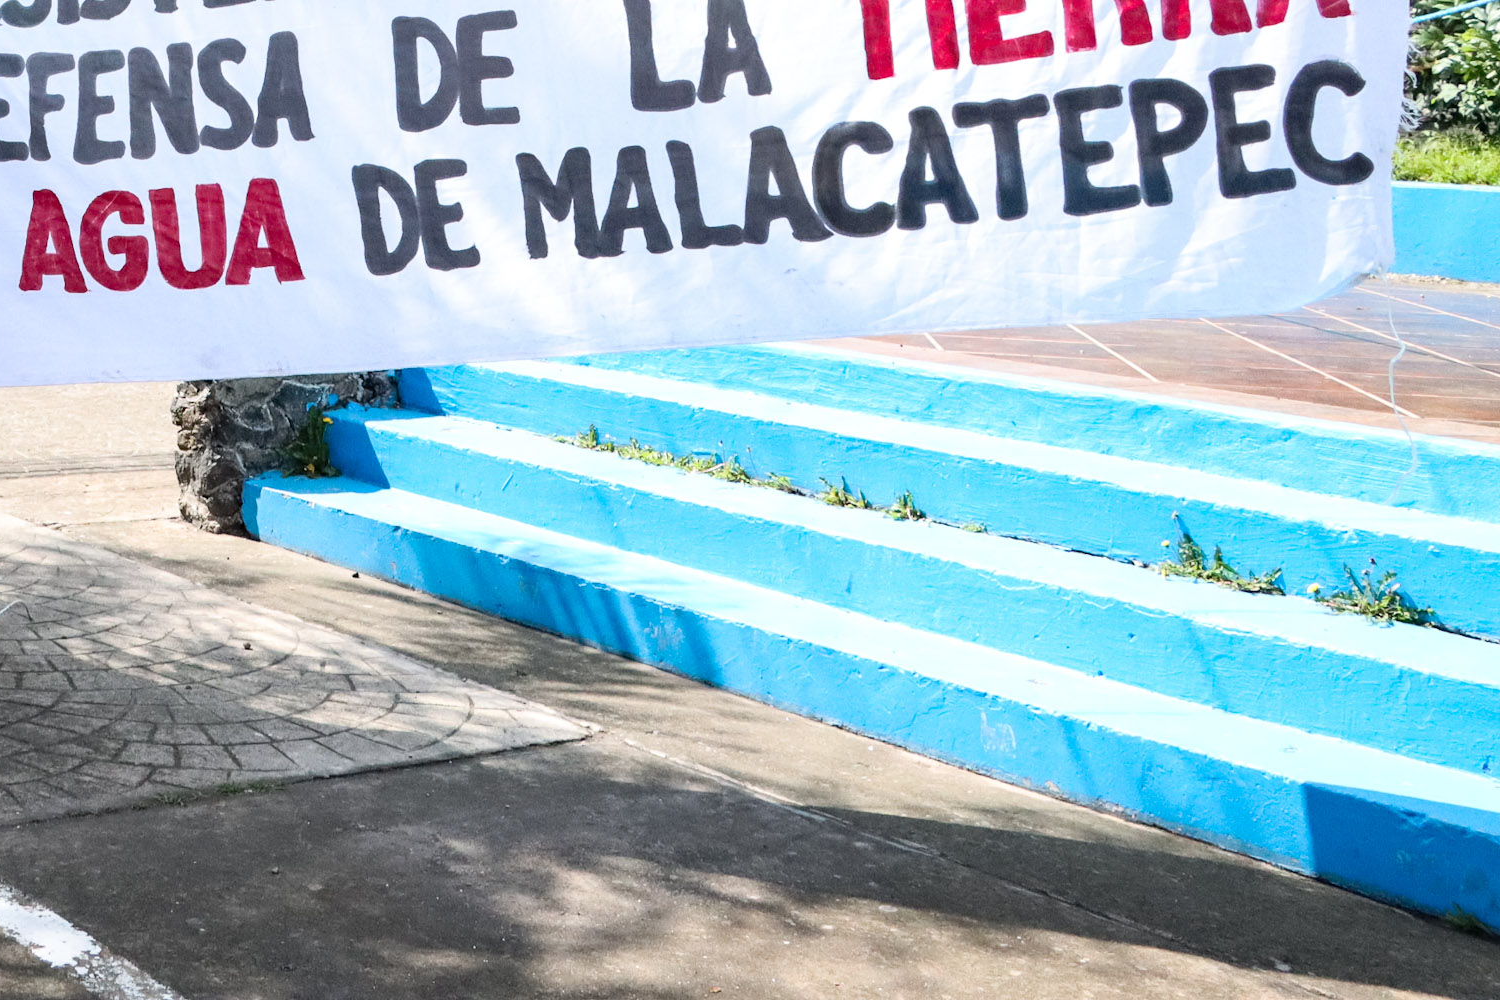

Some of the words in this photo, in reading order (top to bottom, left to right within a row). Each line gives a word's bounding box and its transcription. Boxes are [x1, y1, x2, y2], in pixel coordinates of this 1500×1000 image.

[392, 10, 521, 133] DE
[18, 178, 306, 294] AGUA
[351, 159, 481, 276] DE
[515, 59, 1376, 260] MALACATEPEC
